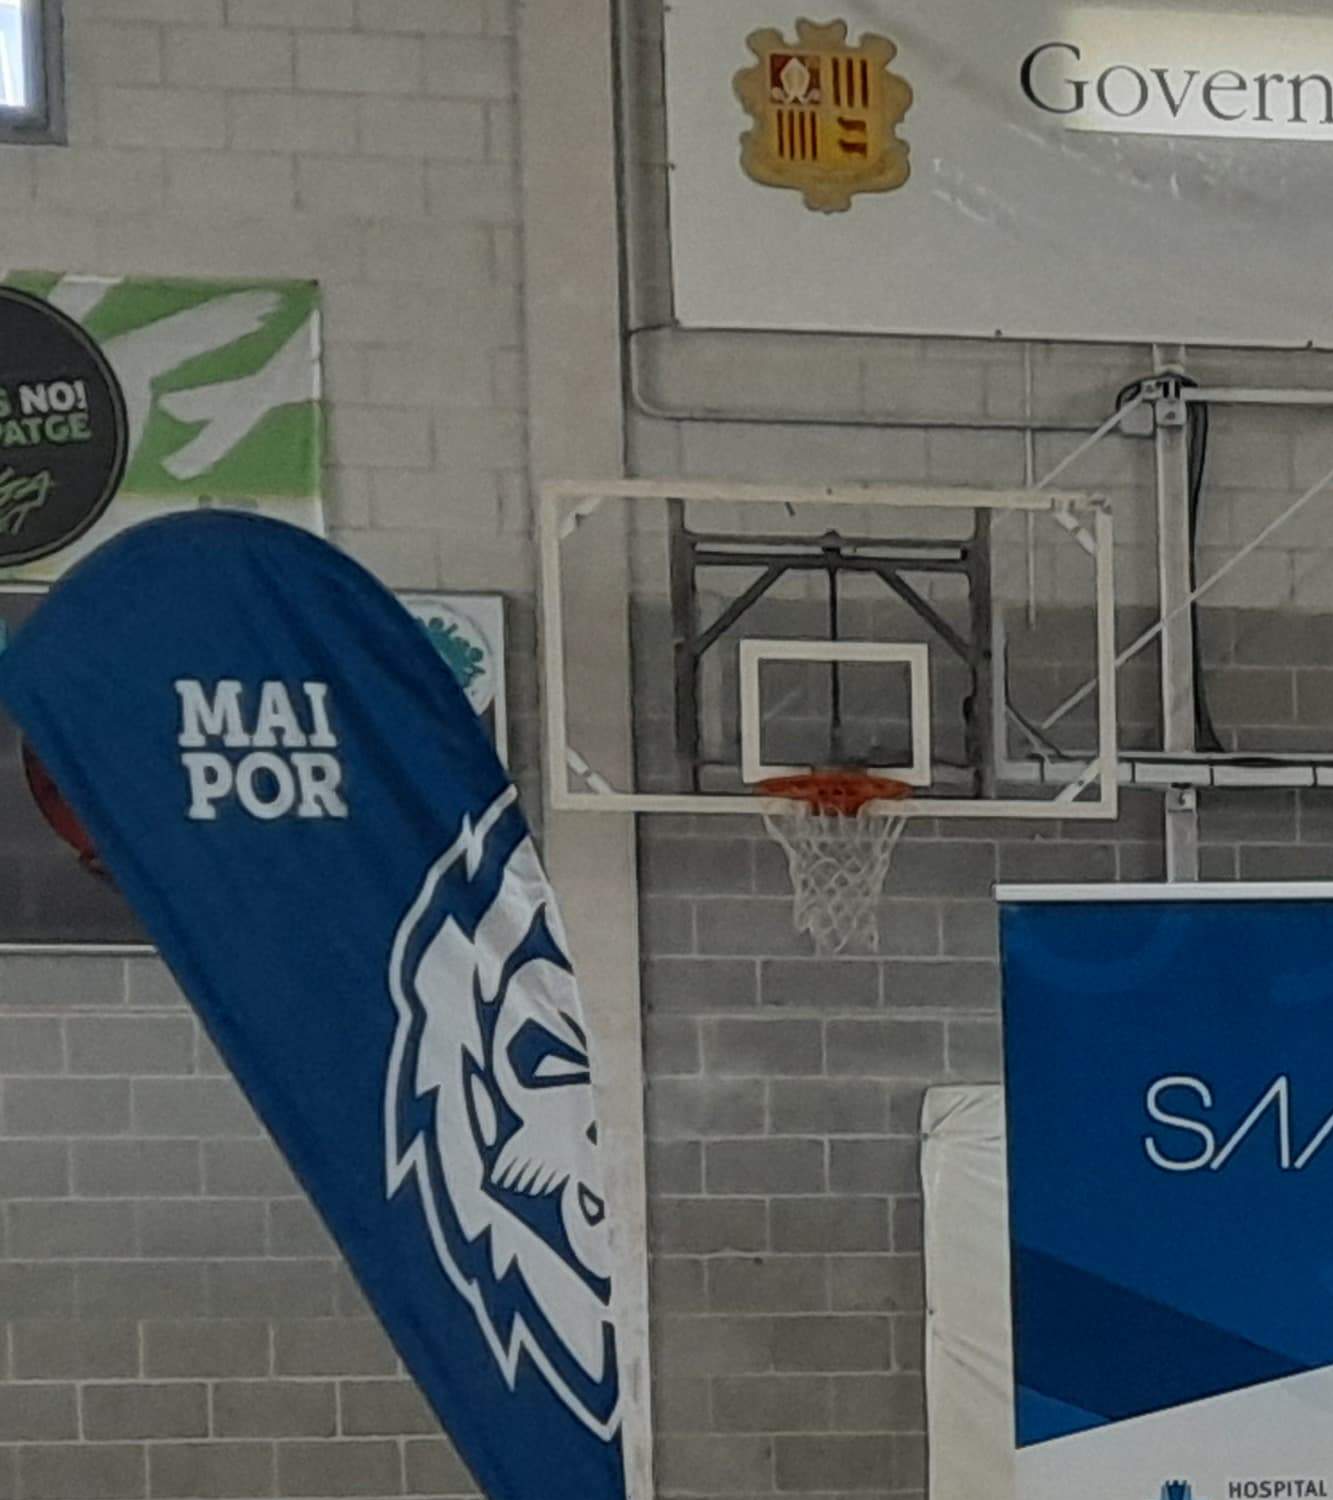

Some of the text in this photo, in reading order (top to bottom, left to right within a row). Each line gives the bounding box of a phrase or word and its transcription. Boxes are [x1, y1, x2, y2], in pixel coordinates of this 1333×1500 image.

[19, 380, 88, 415] NO!
[0, 412, 92, 446] ATGE
[174, 679, 338, 748] MAI
[181, 751, 348, 820] POR
[1228, 1479, 1328, 1499] HOSPITAL
